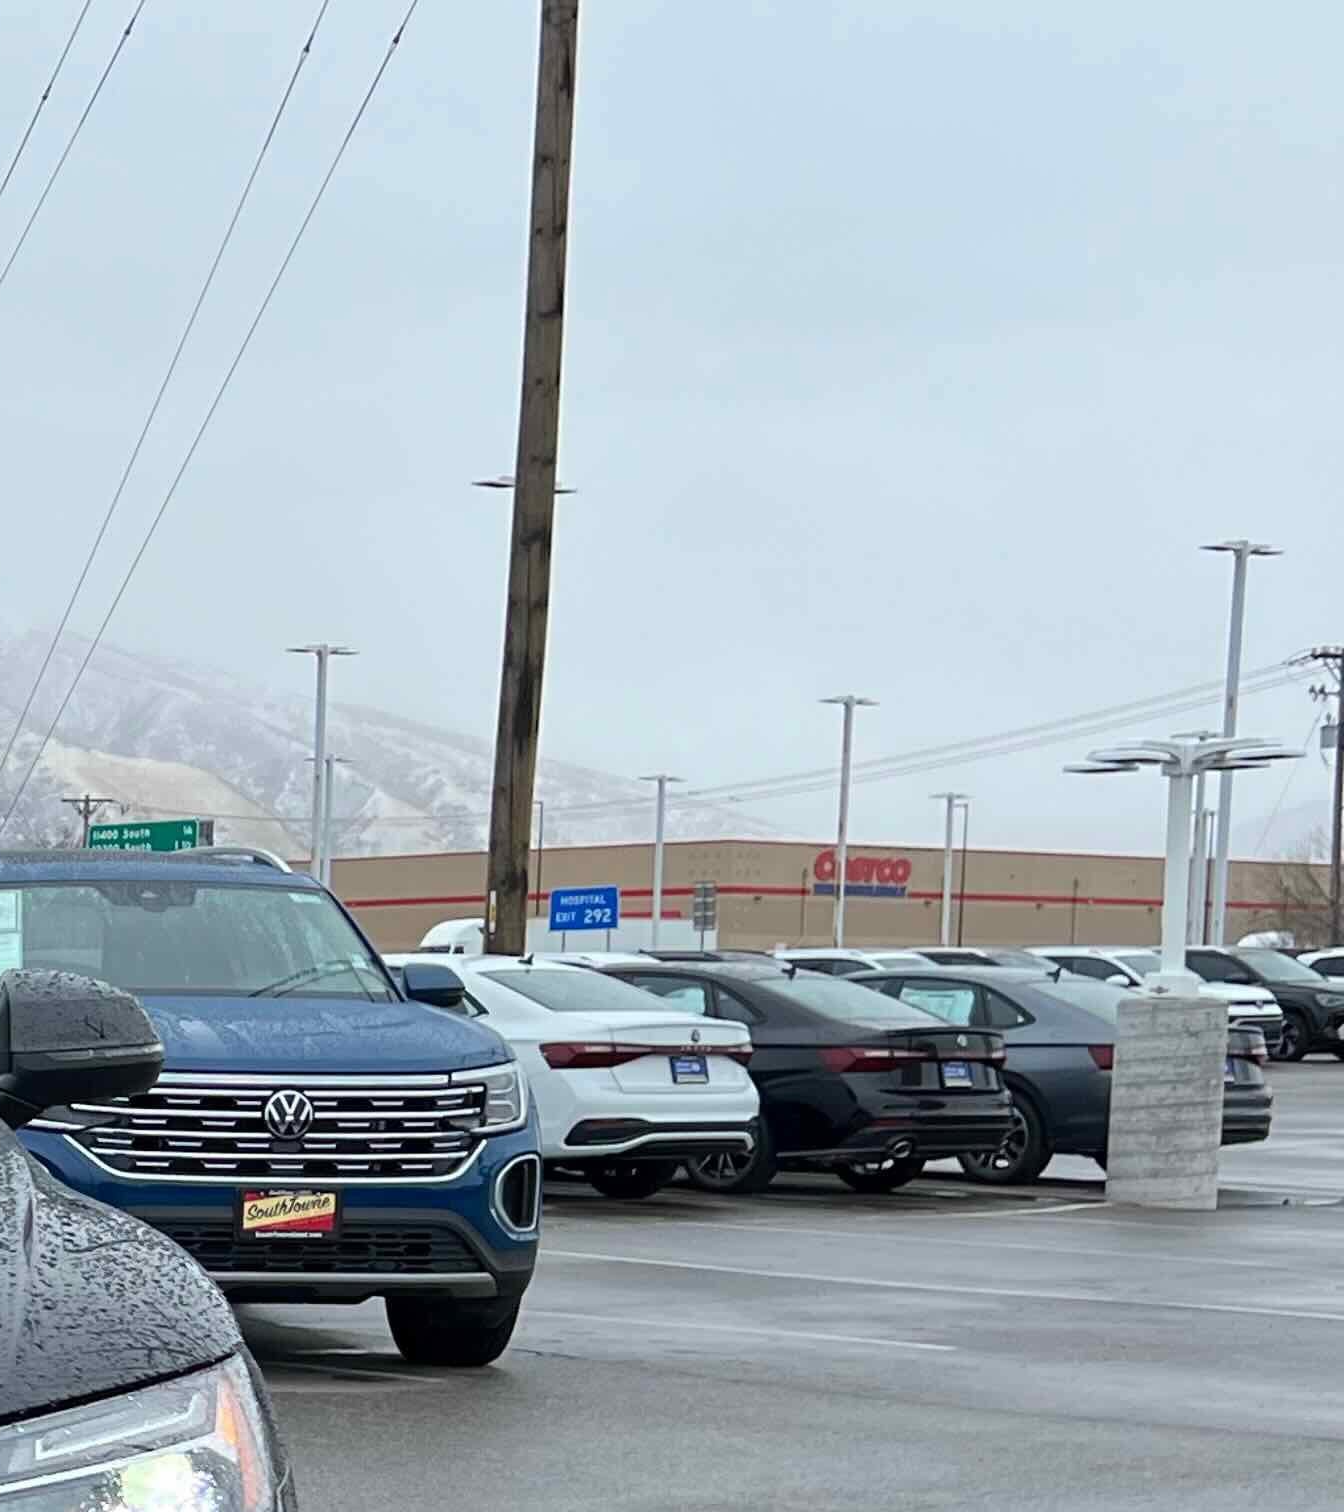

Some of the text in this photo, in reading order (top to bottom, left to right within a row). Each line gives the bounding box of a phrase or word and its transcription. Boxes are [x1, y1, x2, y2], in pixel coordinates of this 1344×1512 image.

[122, 828, 151, 840] South
[556, 908, 611, 924] EXIT 292
